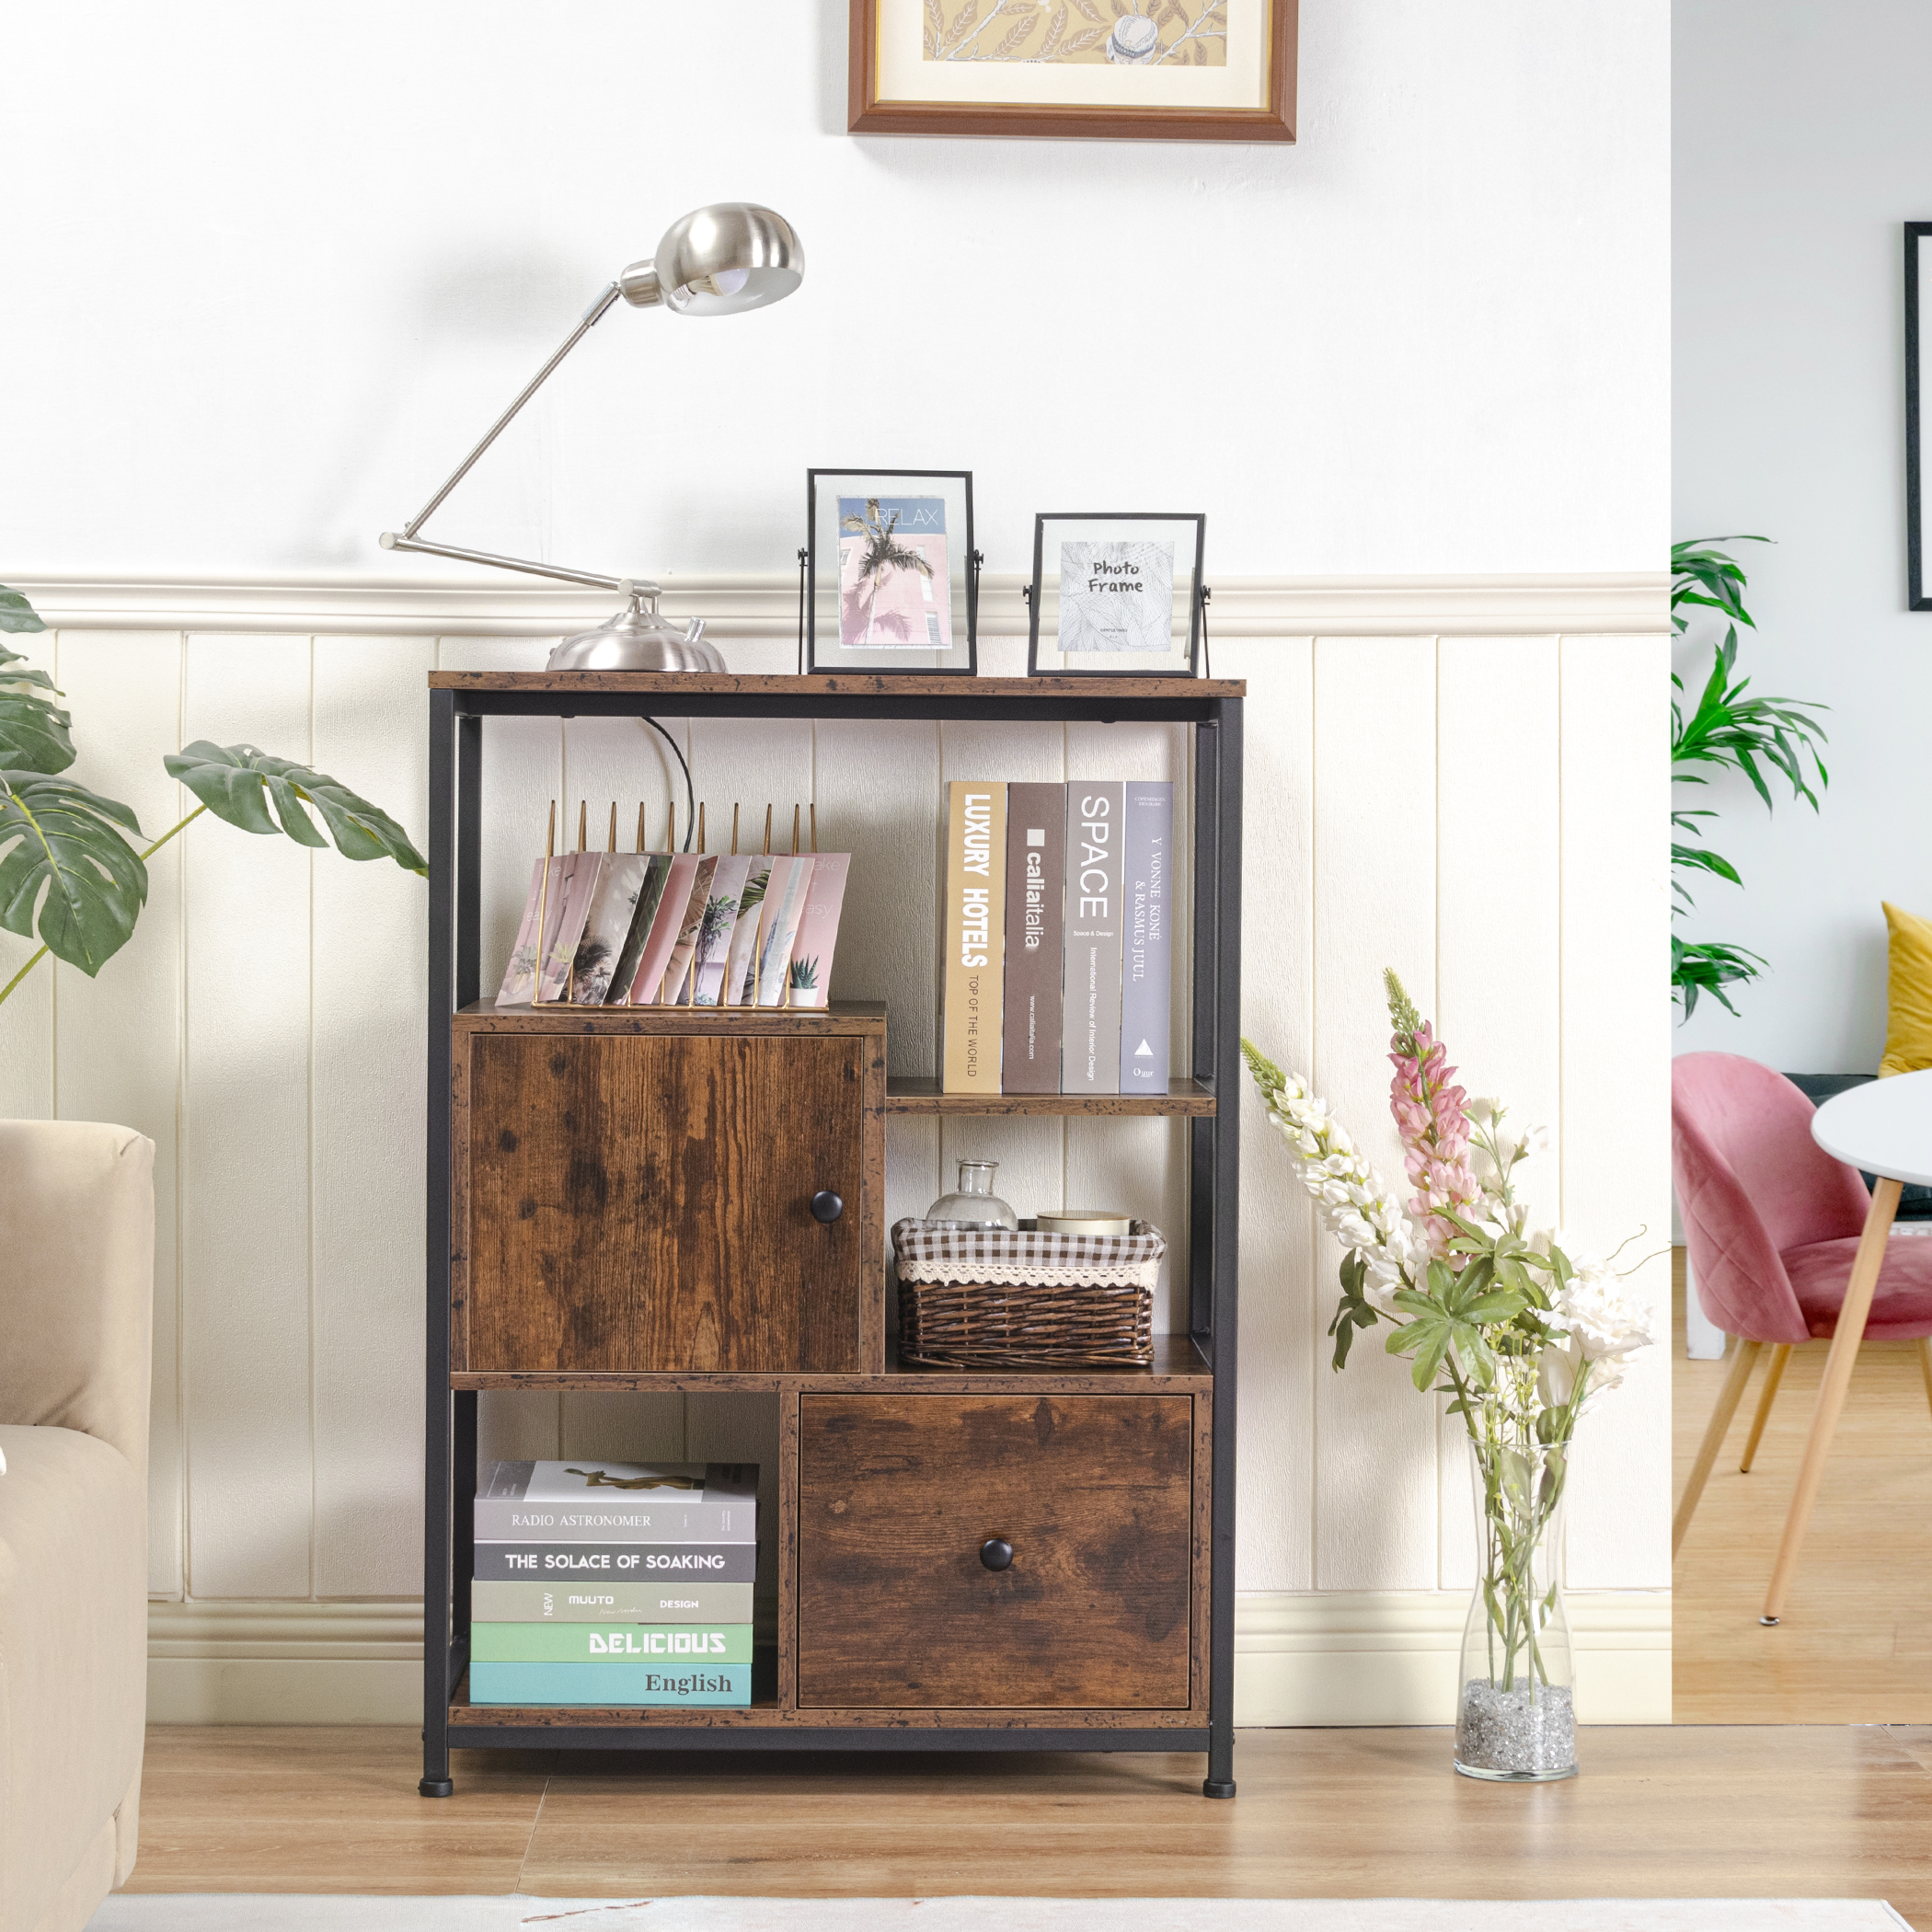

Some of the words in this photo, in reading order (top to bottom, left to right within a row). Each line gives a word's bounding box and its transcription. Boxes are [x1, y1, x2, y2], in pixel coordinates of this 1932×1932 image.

[875, 508, 938, 525] RELAX
[1093, 559, 1140, 575] Photo
[1088, 579, 1144, 593] Frame
[963, 794, 991, 877] LUXURY
[813, 857, 841, 871] ake
[1079, 795, 1110, 918] SPACE
[1135, 880, 1146, 890] &
[1150, 851, 1162, 898] VONNE
[803, 903, 834, 919] asy
[1025, 852, 1045, 949] caliaitalia
[961, 888, 989, 968] HOTELS
[1134, 893, 1146, 946] RASMUS
[1089, 947, 1098, 992] International
[1132, 948, 1144, 982] JUUL
[968, 974, 979, 995] TOP
[968, 997, 978, 1012] OF
[1089, 994, 1098, 1018] Review
[968, 1015, 978, 1036] THE
[1089, 1019, 1097, 1028] of
[1088, 1029, 1097, 1055] Interior
[967, 1039, 977, 1077] WORLD
[1087, 1056, 1097, 1081] Design
[512, 1514, 555, 1526] RADIO
[559, 1514, 651, 1527] ASTRONOMER
[505, 1554, 538, 1569] THE
[545, 1554, 610, 1569] SOLACE
[617, 1554, 640, 1569] OF
[646, 1554, 725, 1570] SOAKING
[544, 1593, 554, 1616] NEW
[569, 1595, 615, 1605] MUUTO
[660, 1600, 699, 1609] DESIGN
[589, 1632, 727, 1654] DELICIOUS
[645, 1673, 733, 1696] English
